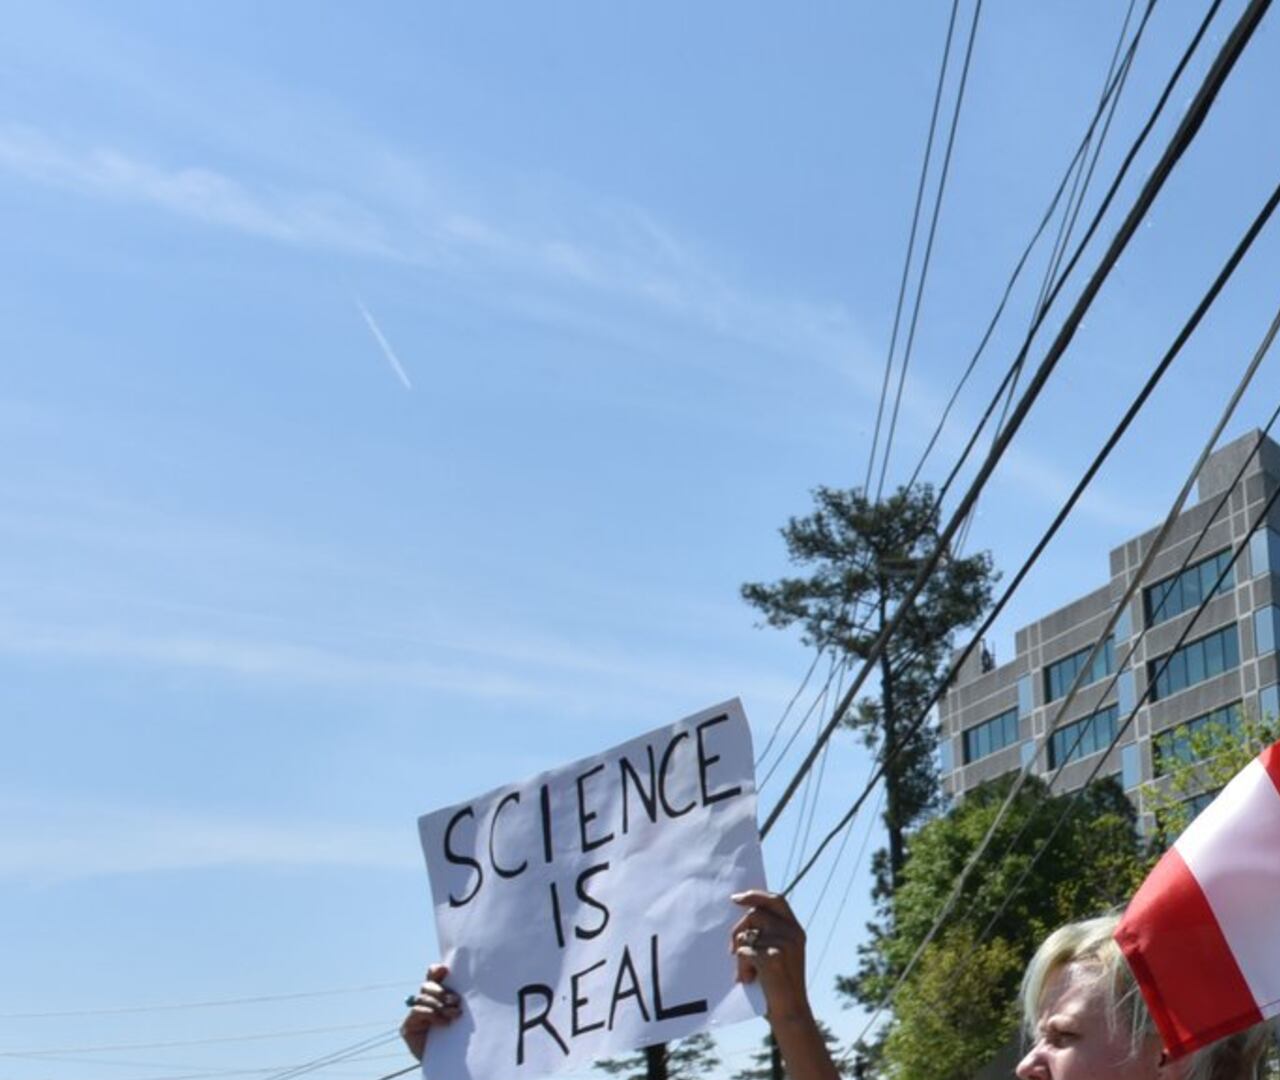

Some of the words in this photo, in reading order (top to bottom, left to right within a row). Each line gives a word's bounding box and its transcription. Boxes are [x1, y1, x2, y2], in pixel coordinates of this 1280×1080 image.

[443, 714, 742, 908] SCIENCE
[549, 862, 611, 948] IS
[516, 934, 708, 1066] REAL
